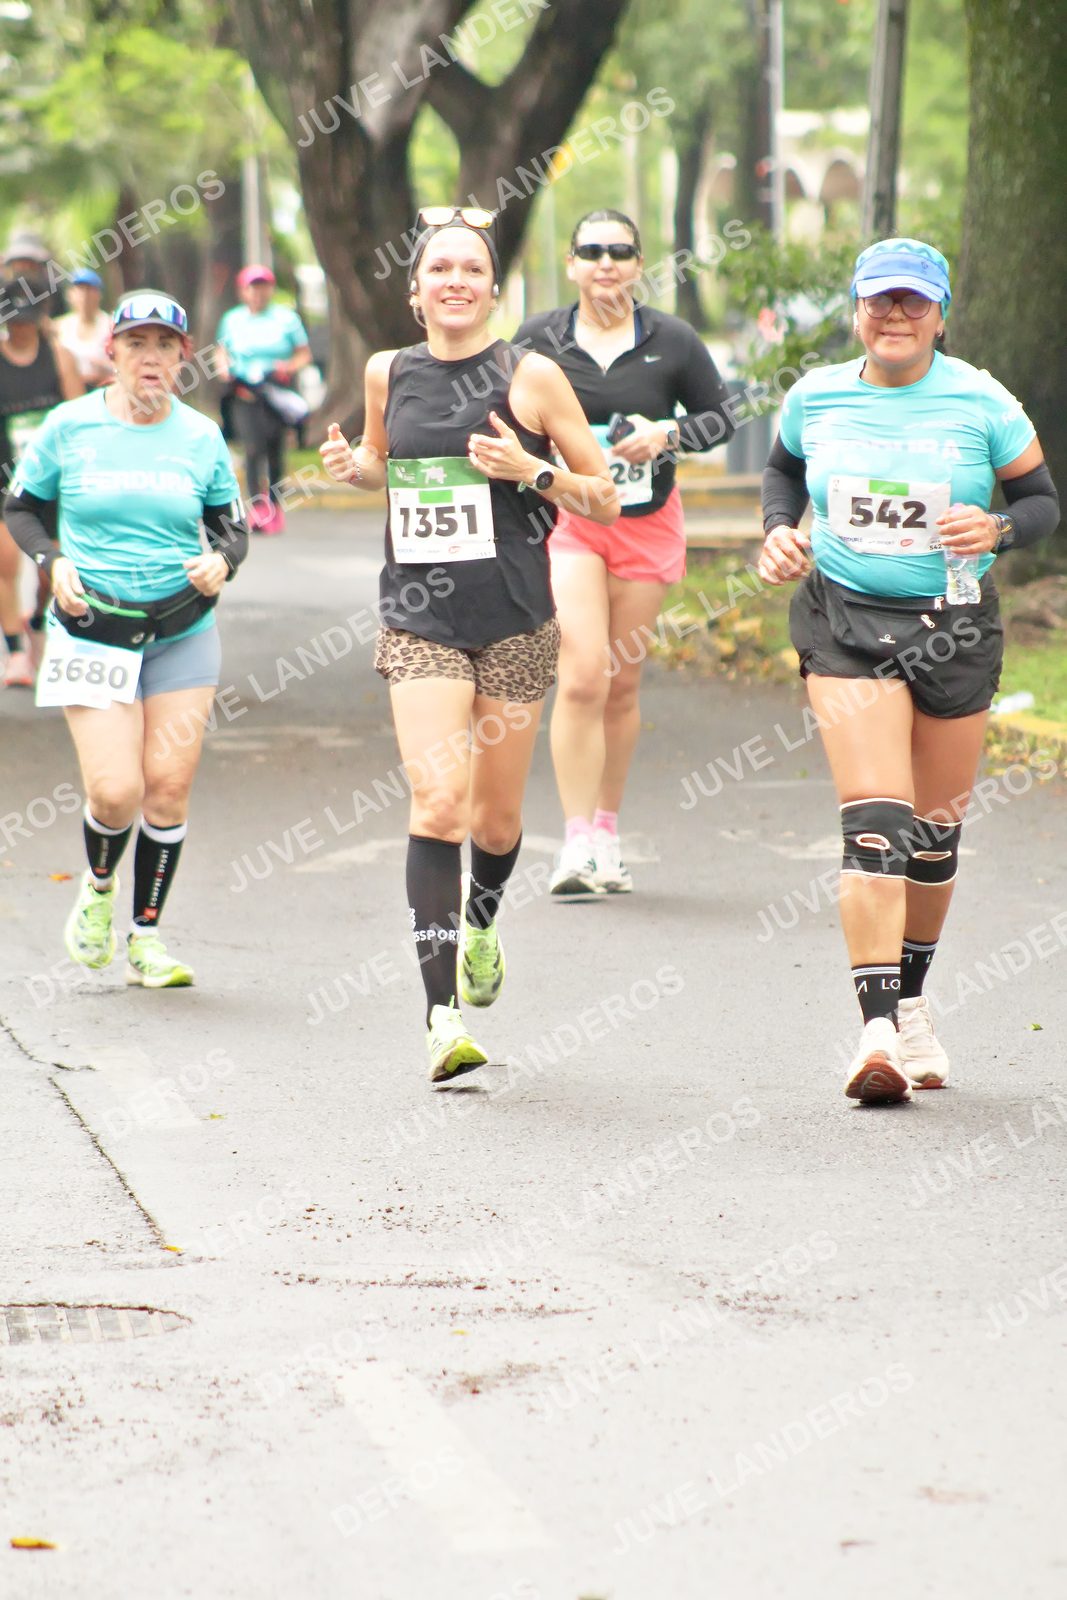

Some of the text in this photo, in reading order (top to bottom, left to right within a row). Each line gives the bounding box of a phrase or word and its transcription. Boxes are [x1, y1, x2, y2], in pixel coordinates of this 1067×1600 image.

[399, 504, 478, 538] 1351
[849, 496, 927, 529] 542
[47, 658, 128, 690] 3680
